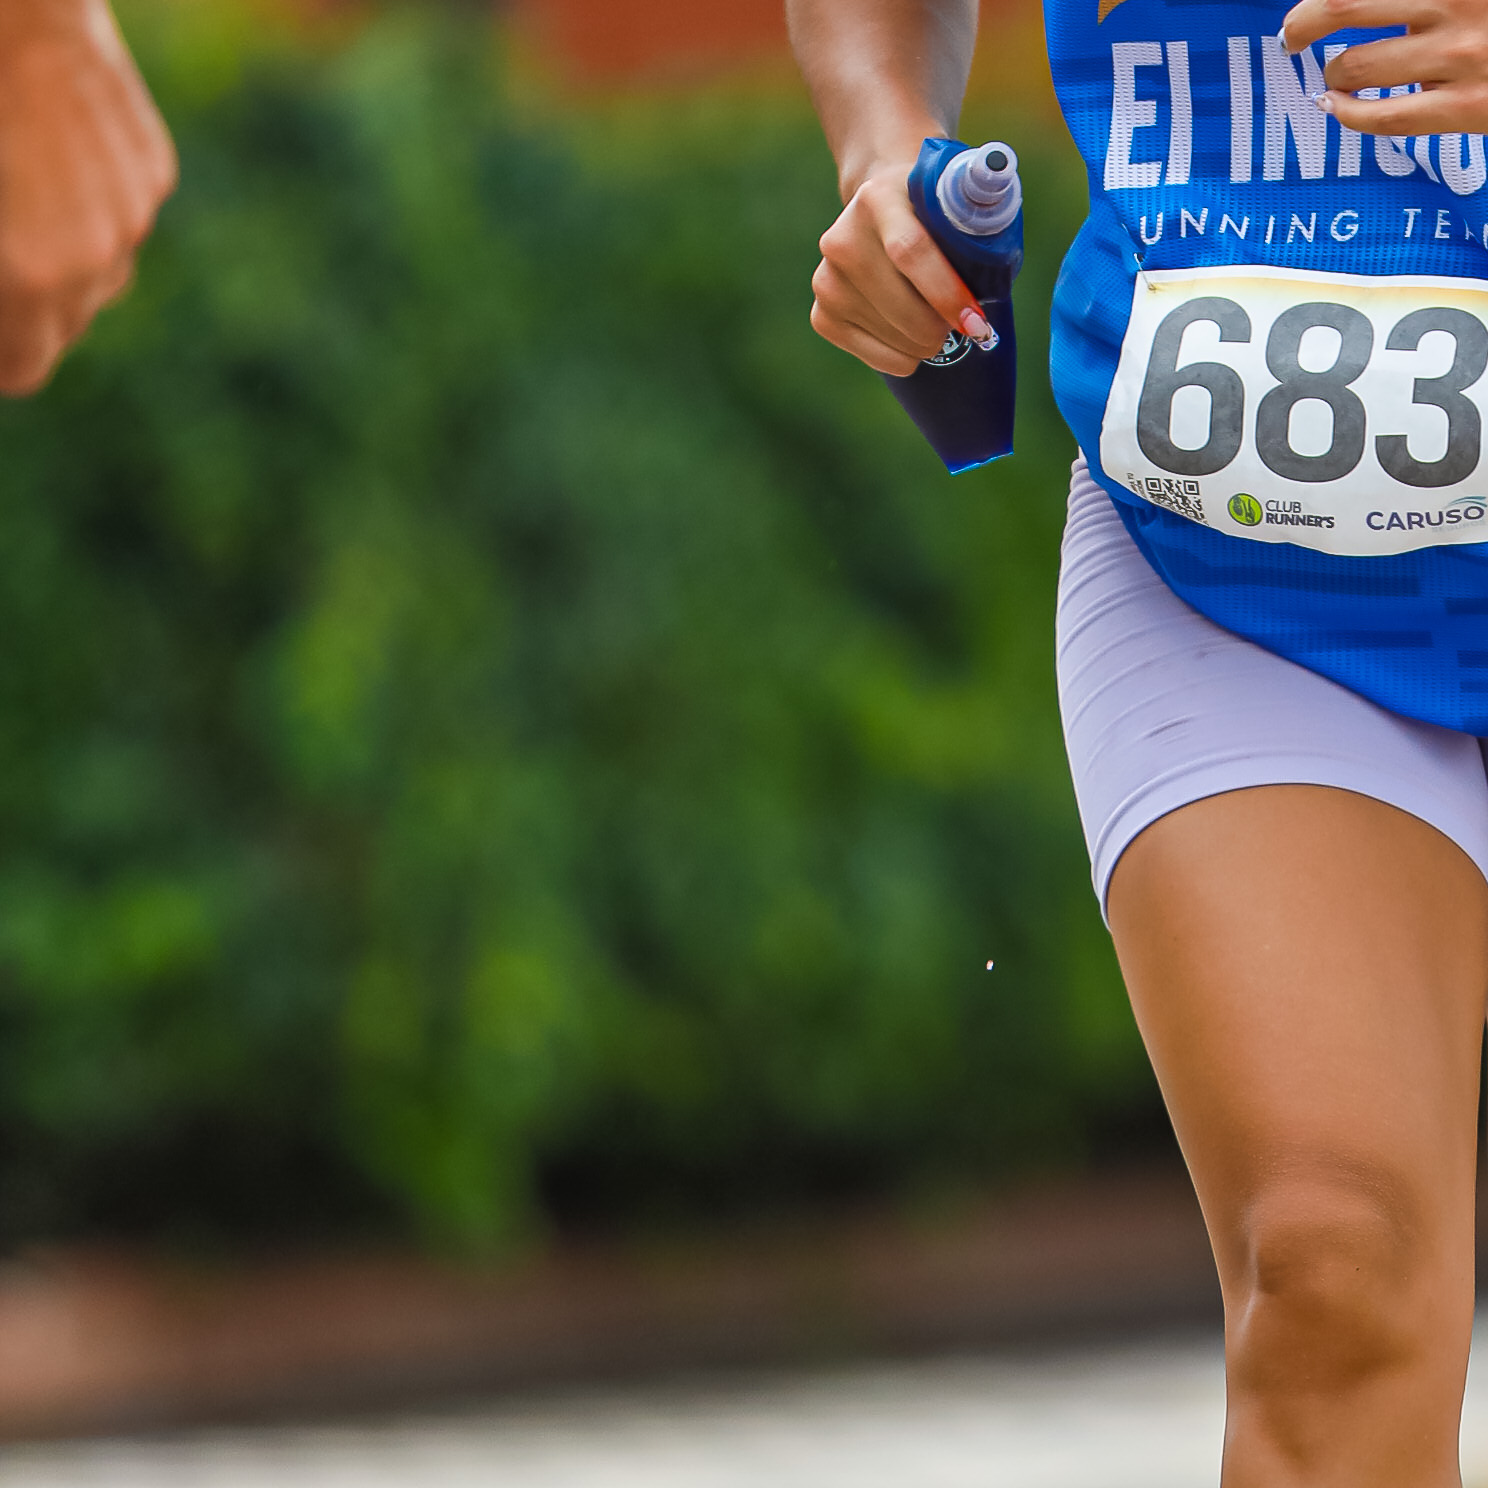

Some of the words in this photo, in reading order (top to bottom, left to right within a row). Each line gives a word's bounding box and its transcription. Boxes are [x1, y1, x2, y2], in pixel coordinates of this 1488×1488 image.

[1122, 207, 1360, 245] UNNING
[1265, 499, 1302, 513] CLUB
[1265, 512, 1335, 529] RUNNER'S
[1365, 505, 1485, 531] CARUSO
